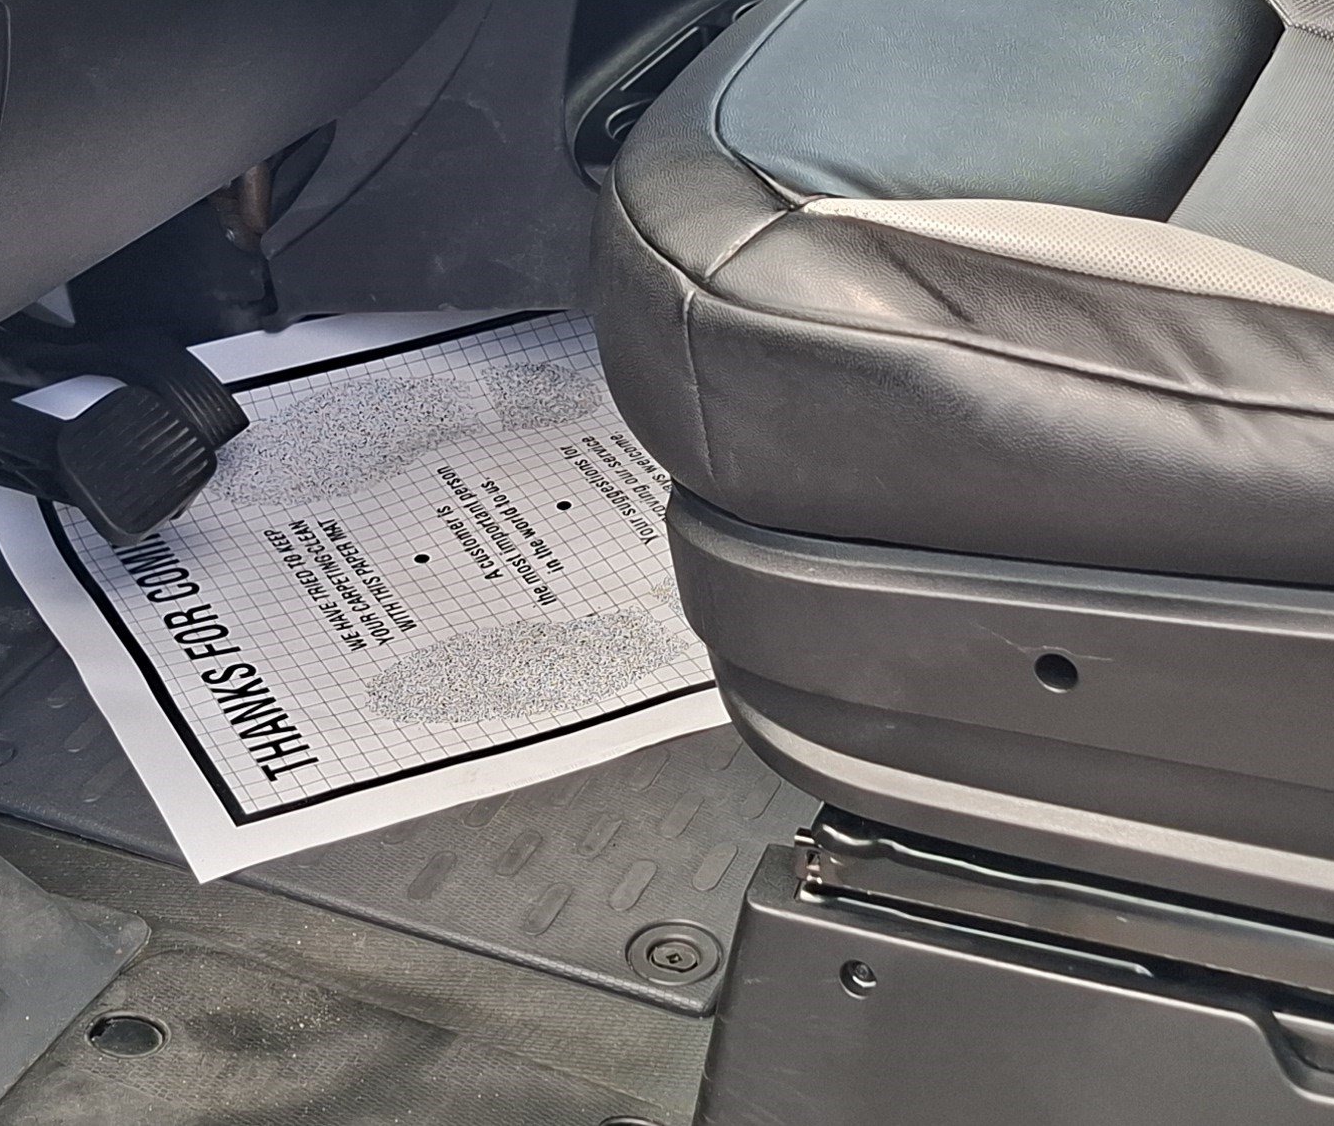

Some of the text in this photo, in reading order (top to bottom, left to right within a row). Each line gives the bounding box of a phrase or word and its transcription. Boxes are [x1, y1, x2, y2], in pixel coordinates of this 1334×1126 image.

[493, 493, 510, 508] to
[499, 506, 536, 539] world
[560, 445, 659, 545] Your suggestions for
[582, 435, 668, 523] roving our service
[317, 518, 418, 632] WITH THIS PAPER MAT
[437, 465, 557, 606] the most important person
[437, 505, 503, 580] A customer is
[530, 538, 553, 560] the
[546, 558, 564, 574] in
[263, 529, 367, 651] WE HAVE TRIED TO KEEP
[288, 519, 395, 646] YOUR CARPETING CLEAN
[163, 603, 242, 660] FOR
[200, 662, 319, 782] THANKS
